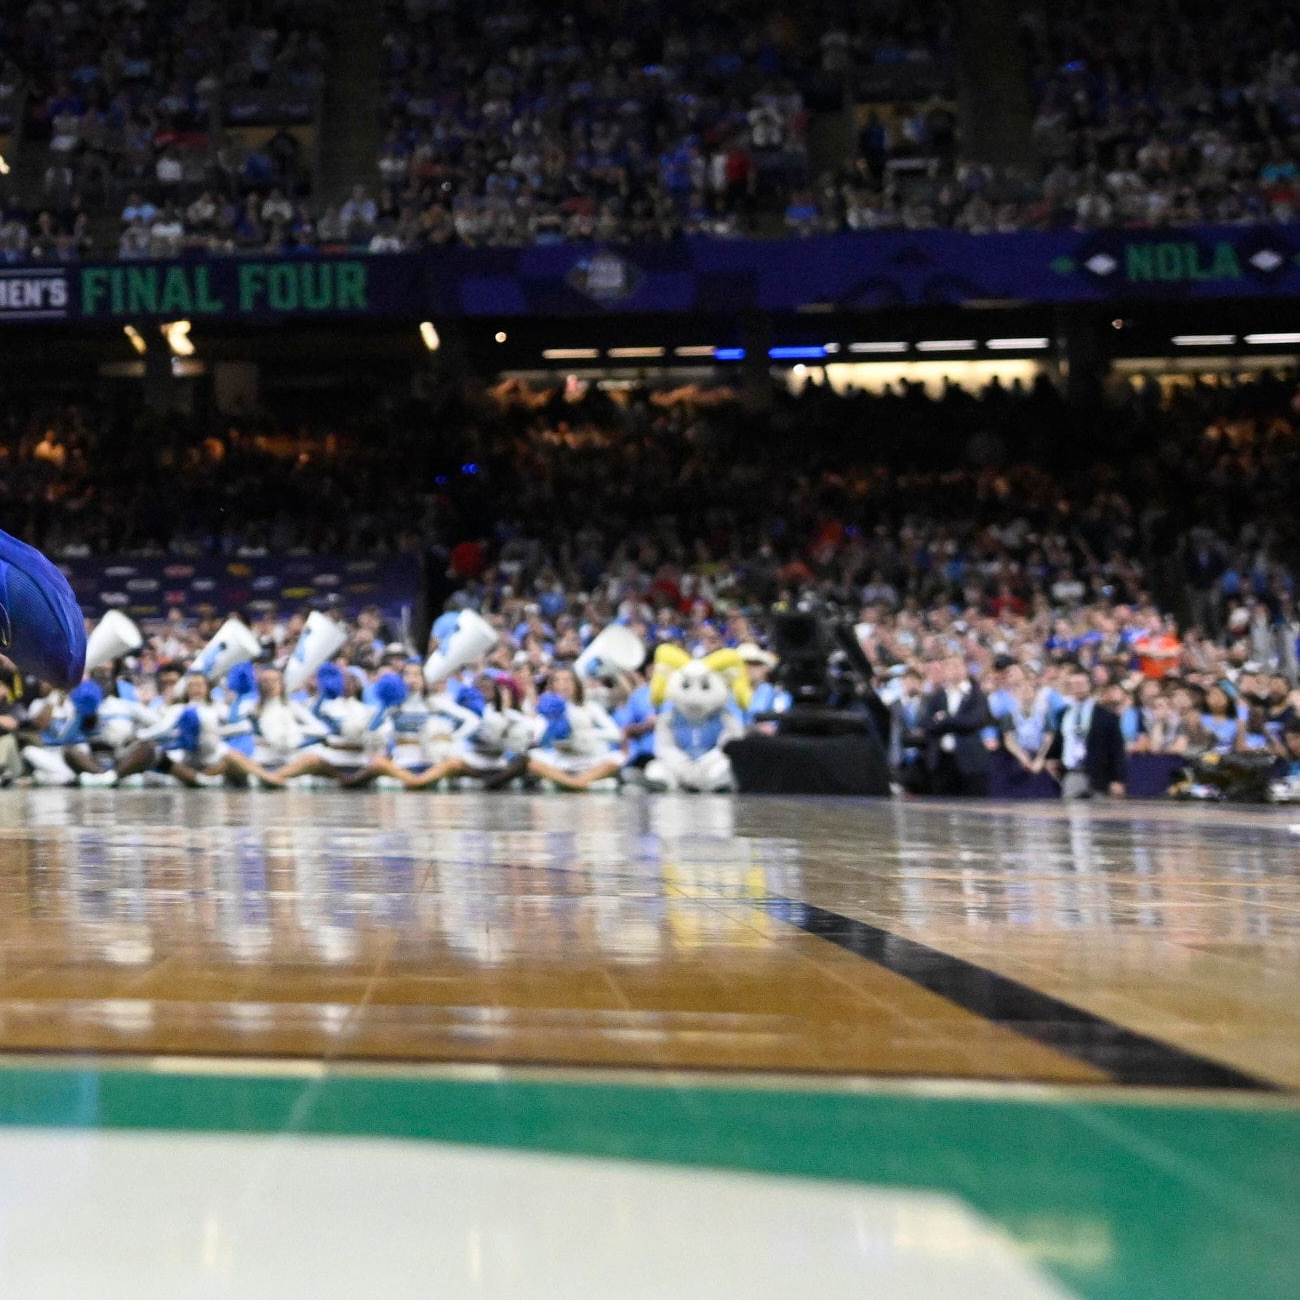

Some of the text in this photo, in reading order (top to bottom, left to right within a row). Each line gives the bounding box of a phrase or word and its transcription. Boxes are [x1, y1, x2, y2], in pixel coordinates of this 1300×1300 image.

[1123, 241, 1242, 282] NOLA
[80, 260, 369, 316] FINAL FOUR
